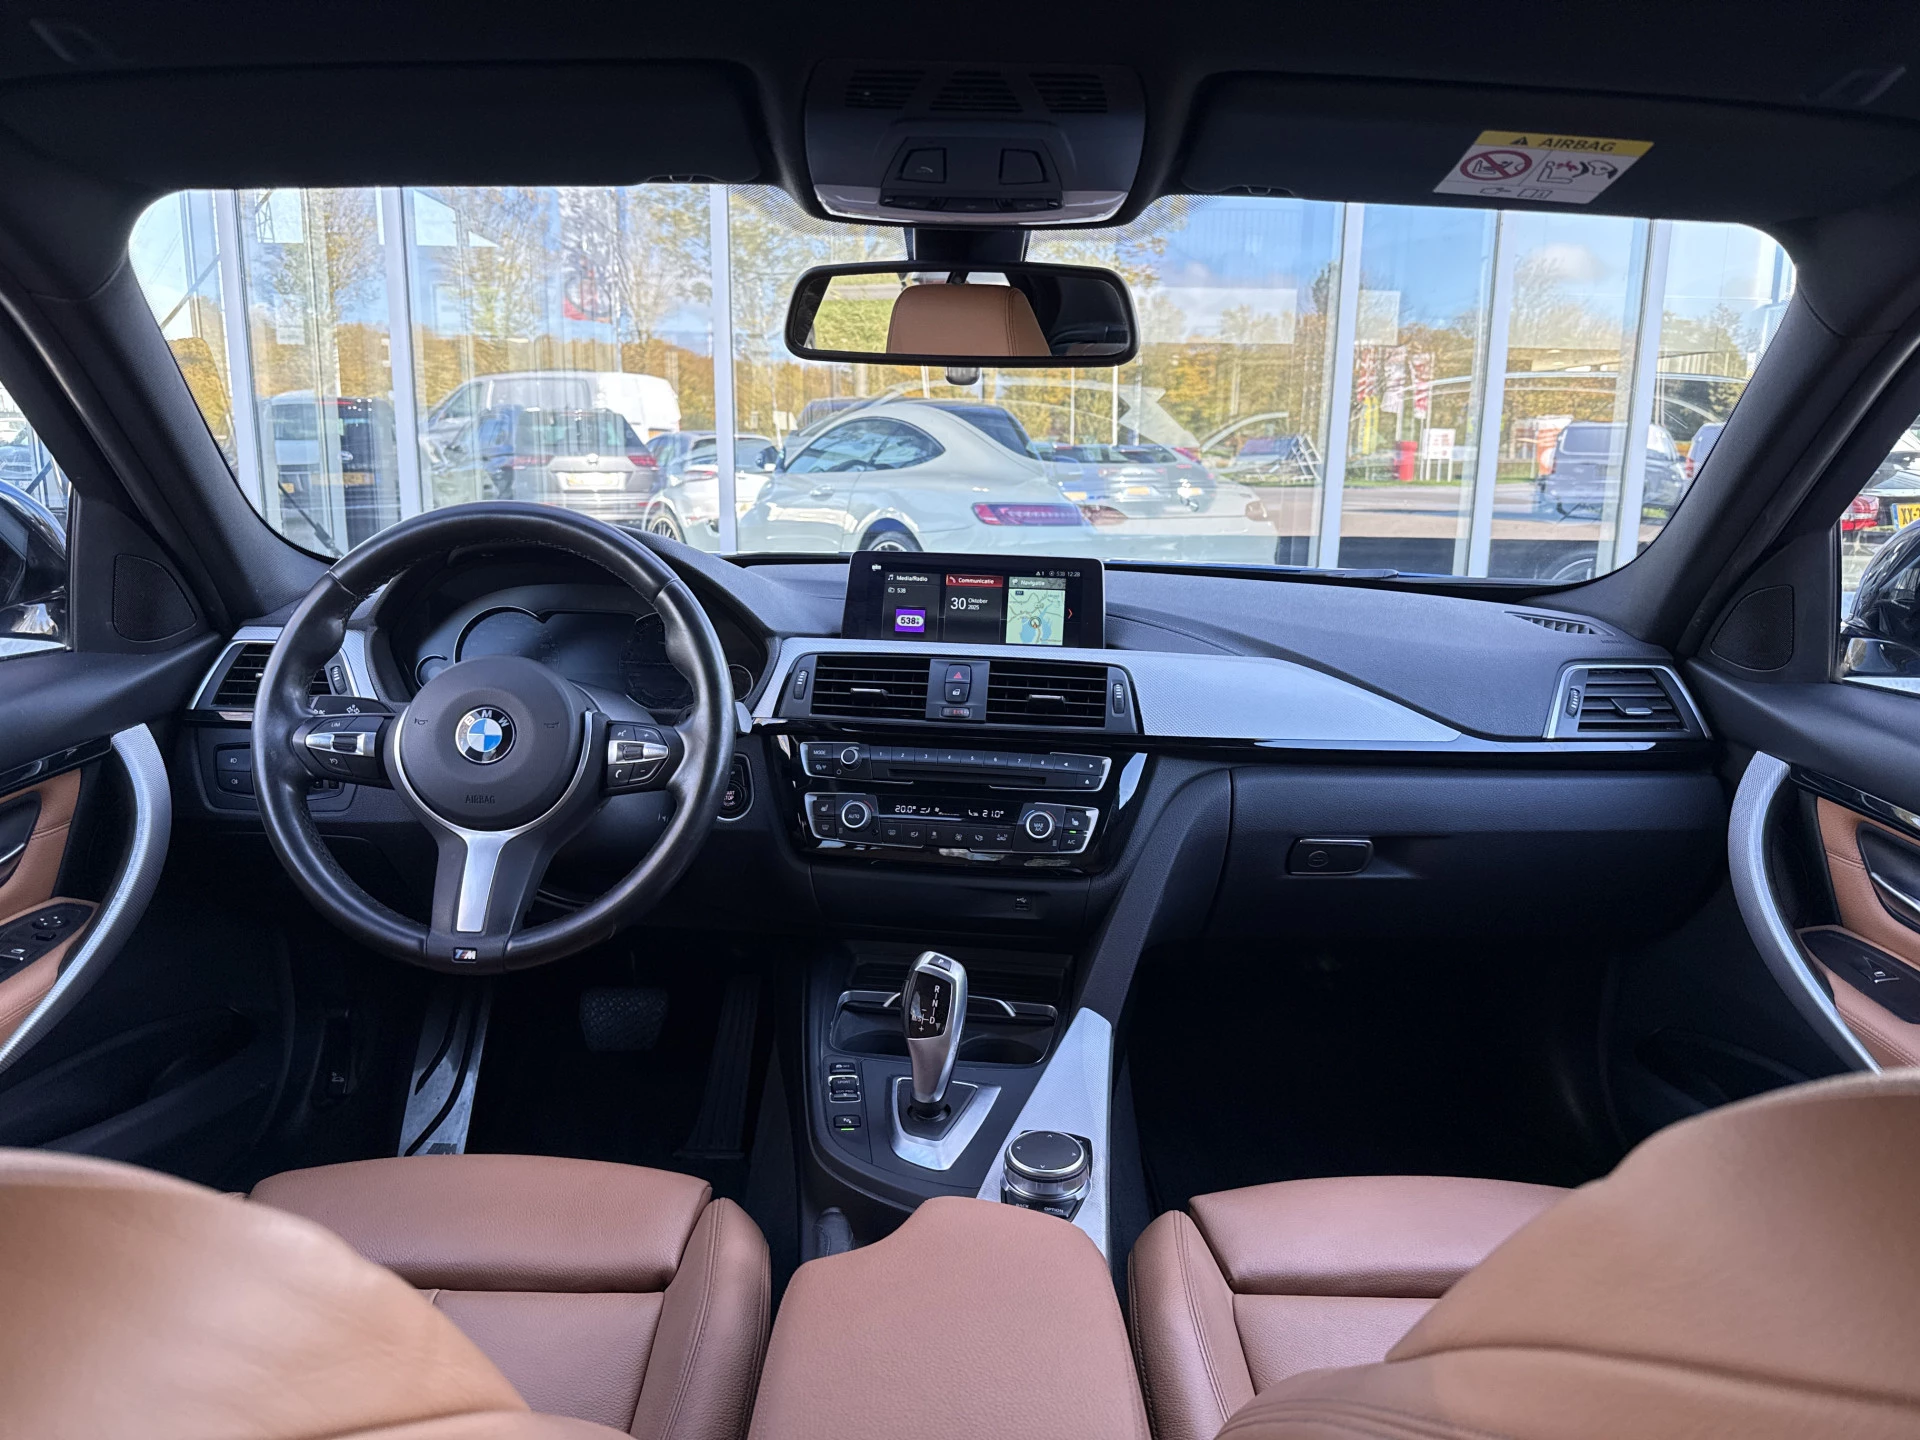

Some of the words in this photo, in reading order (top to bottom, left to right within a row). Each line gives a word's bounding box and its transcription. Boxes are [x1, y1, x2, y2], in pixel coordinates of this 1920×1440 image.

[1538, 137, 1616, 152] AIRBAG
[958, 577, 995, 585] Communicatie
[1020, 579, 1046, 587] Navigatie
[950, 597, 967, 610] 30
[464, 794, 496, 804] AIRBAG
[934, 984, 941, 993] R
[931, 999, 939, 1008] N
[929, 1016, 936, 1025] D
[1043, 1206, 1064, 1214] OPTION
